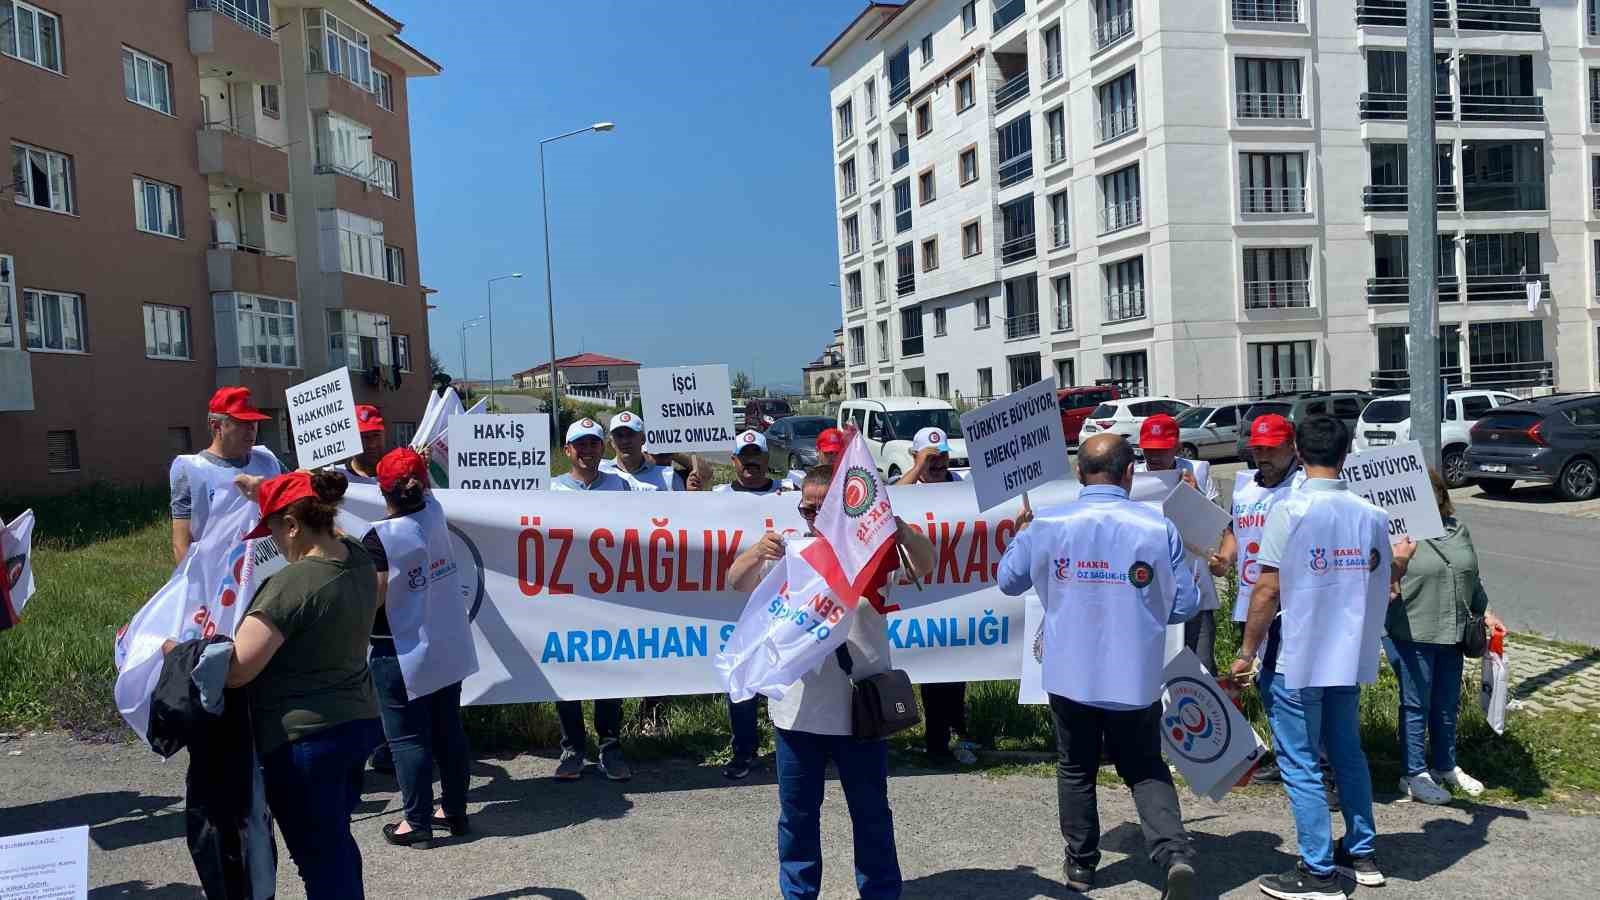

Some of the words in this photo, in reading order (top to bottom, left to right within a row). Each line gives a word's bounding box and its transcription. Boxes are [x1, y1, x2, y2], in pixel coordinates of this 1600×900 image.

[292, 380, 342, 407] SÖZLEŞME
[297, 400, 345, 425] HAKKIMIZ
[661, 399, 715, 418] SENDİKA
[966, 411, 1009, 442] TÜRKİYE
[1009, 392, 1056, 425] BÜYÜYOR,
[297, 428, 323, 445] SÖKE
[324, 418, 351, 436] SÖKE
[473, 420, 525, 443] HAK-İŞ
[647, 429, 682, 444] OMUZ
[684, 427, 735, 443] OMUZA..
[313, 440, 346, 461] ALIRIZ!
[457, 447, 546, 469] NEREDE,BİZ
[984, 434, 1020, 469] EMEKÇİ
[1021, 425, 1051, 452] PAYINI
[1003, 460, 1043, 491] İSTİYOR!
[1361, 455, 1423, 480] BÜYÜYOR,
[1377, 485, 1417, 507] PAYINI
[517, 516, 574, 597] ÖZ
[588, 518, 743, 593] SAĞLIK
[541, 625, 708, 663] ARDAHAN
[886, 608, 1009, 649] KANLIĞI
